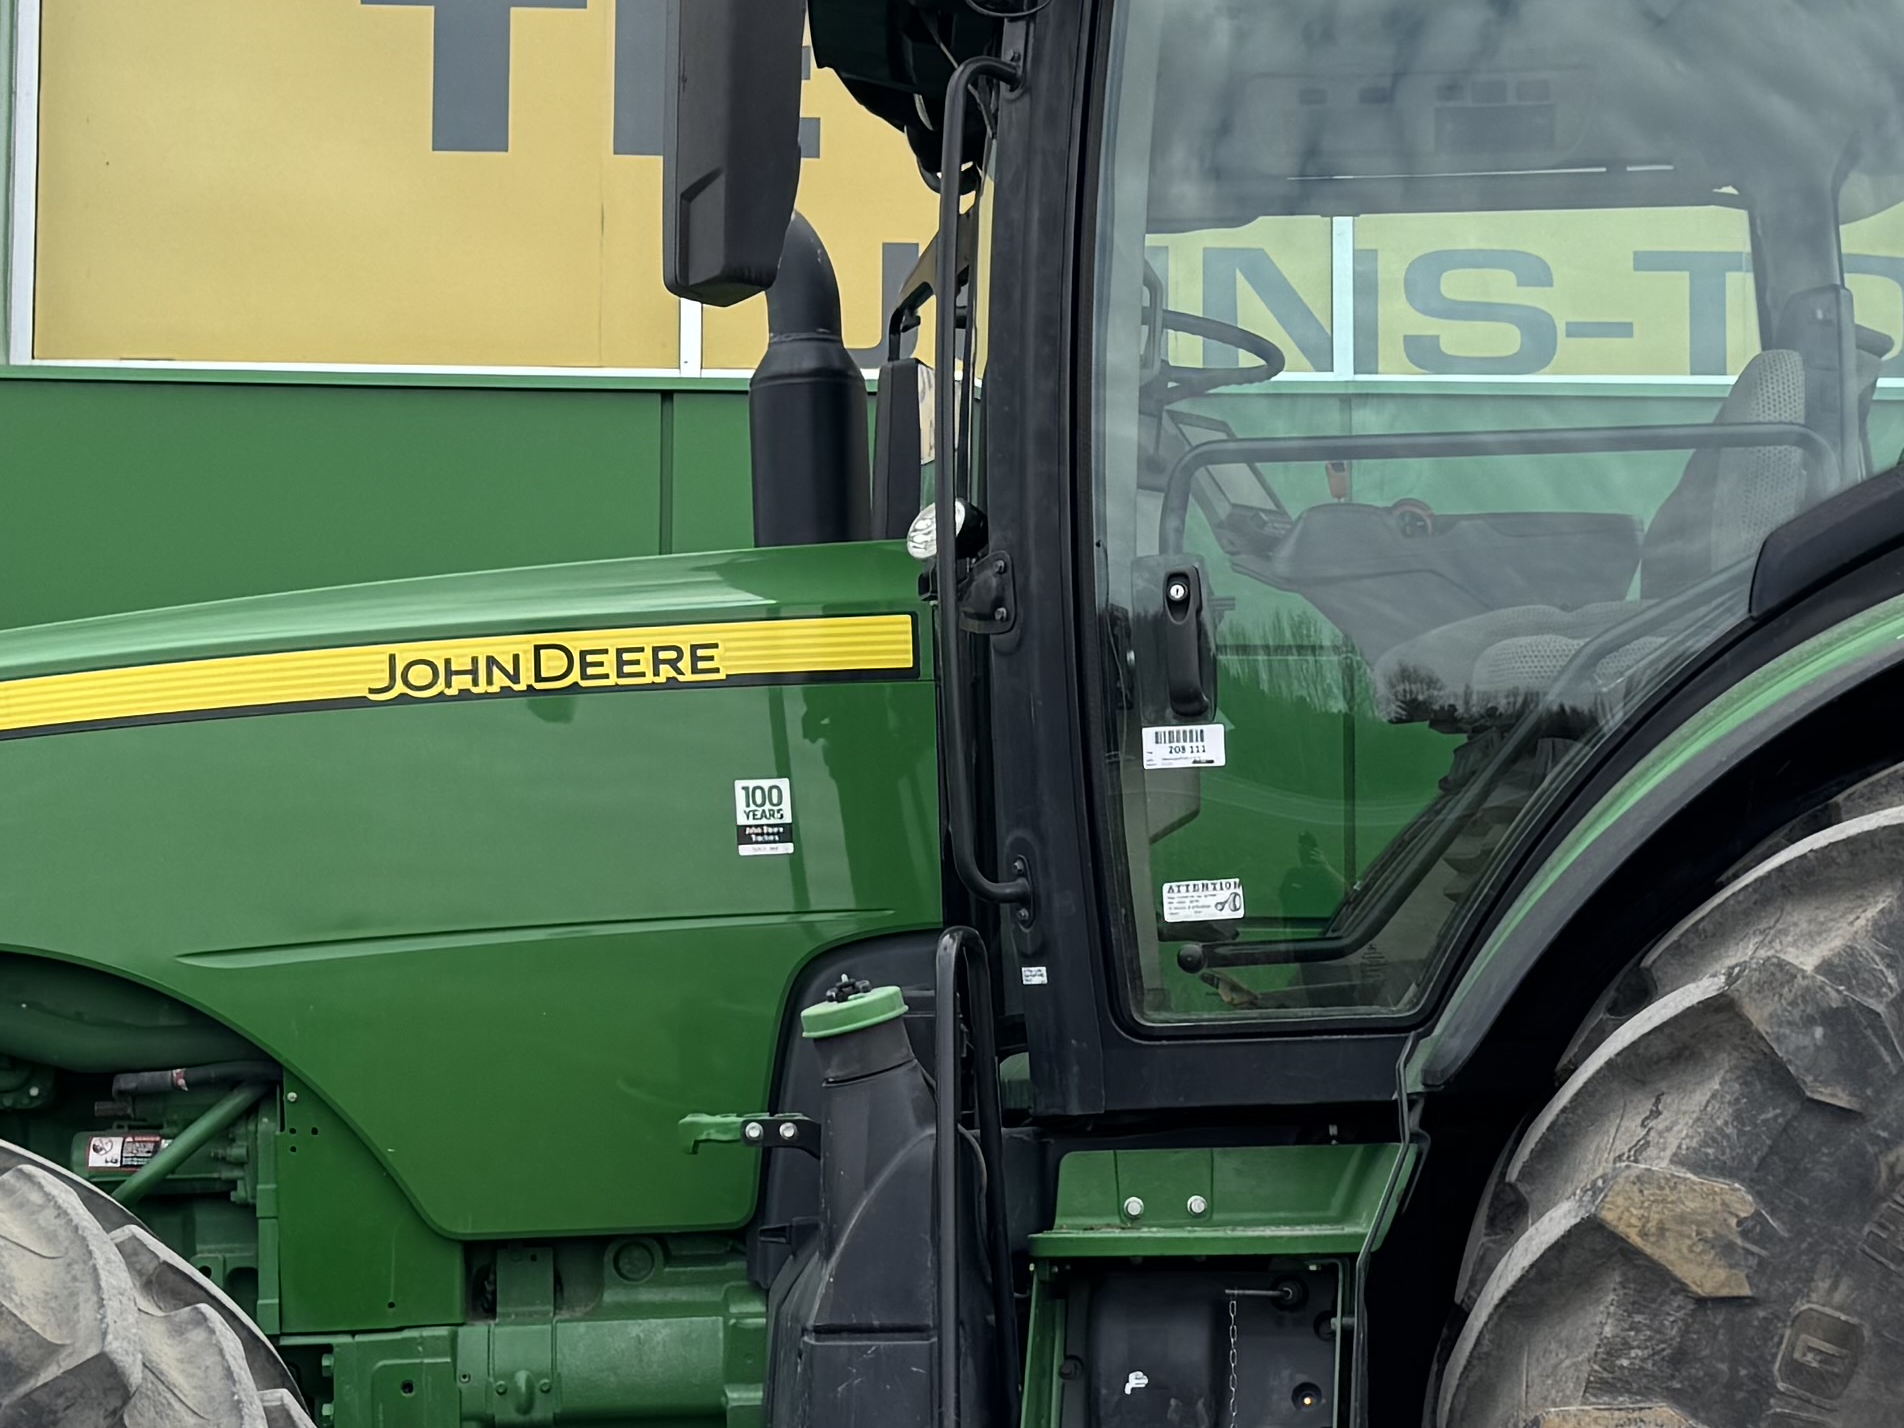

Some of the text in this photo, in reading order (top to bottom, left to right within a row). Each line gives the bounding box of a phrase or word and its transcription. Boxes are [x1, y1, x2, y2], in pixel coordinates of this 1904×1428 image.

[741, 784, 784, 809] 100
[744, 808, 784, 821] YEARS
[1167, 880, 1241, 894] ATTENTION
